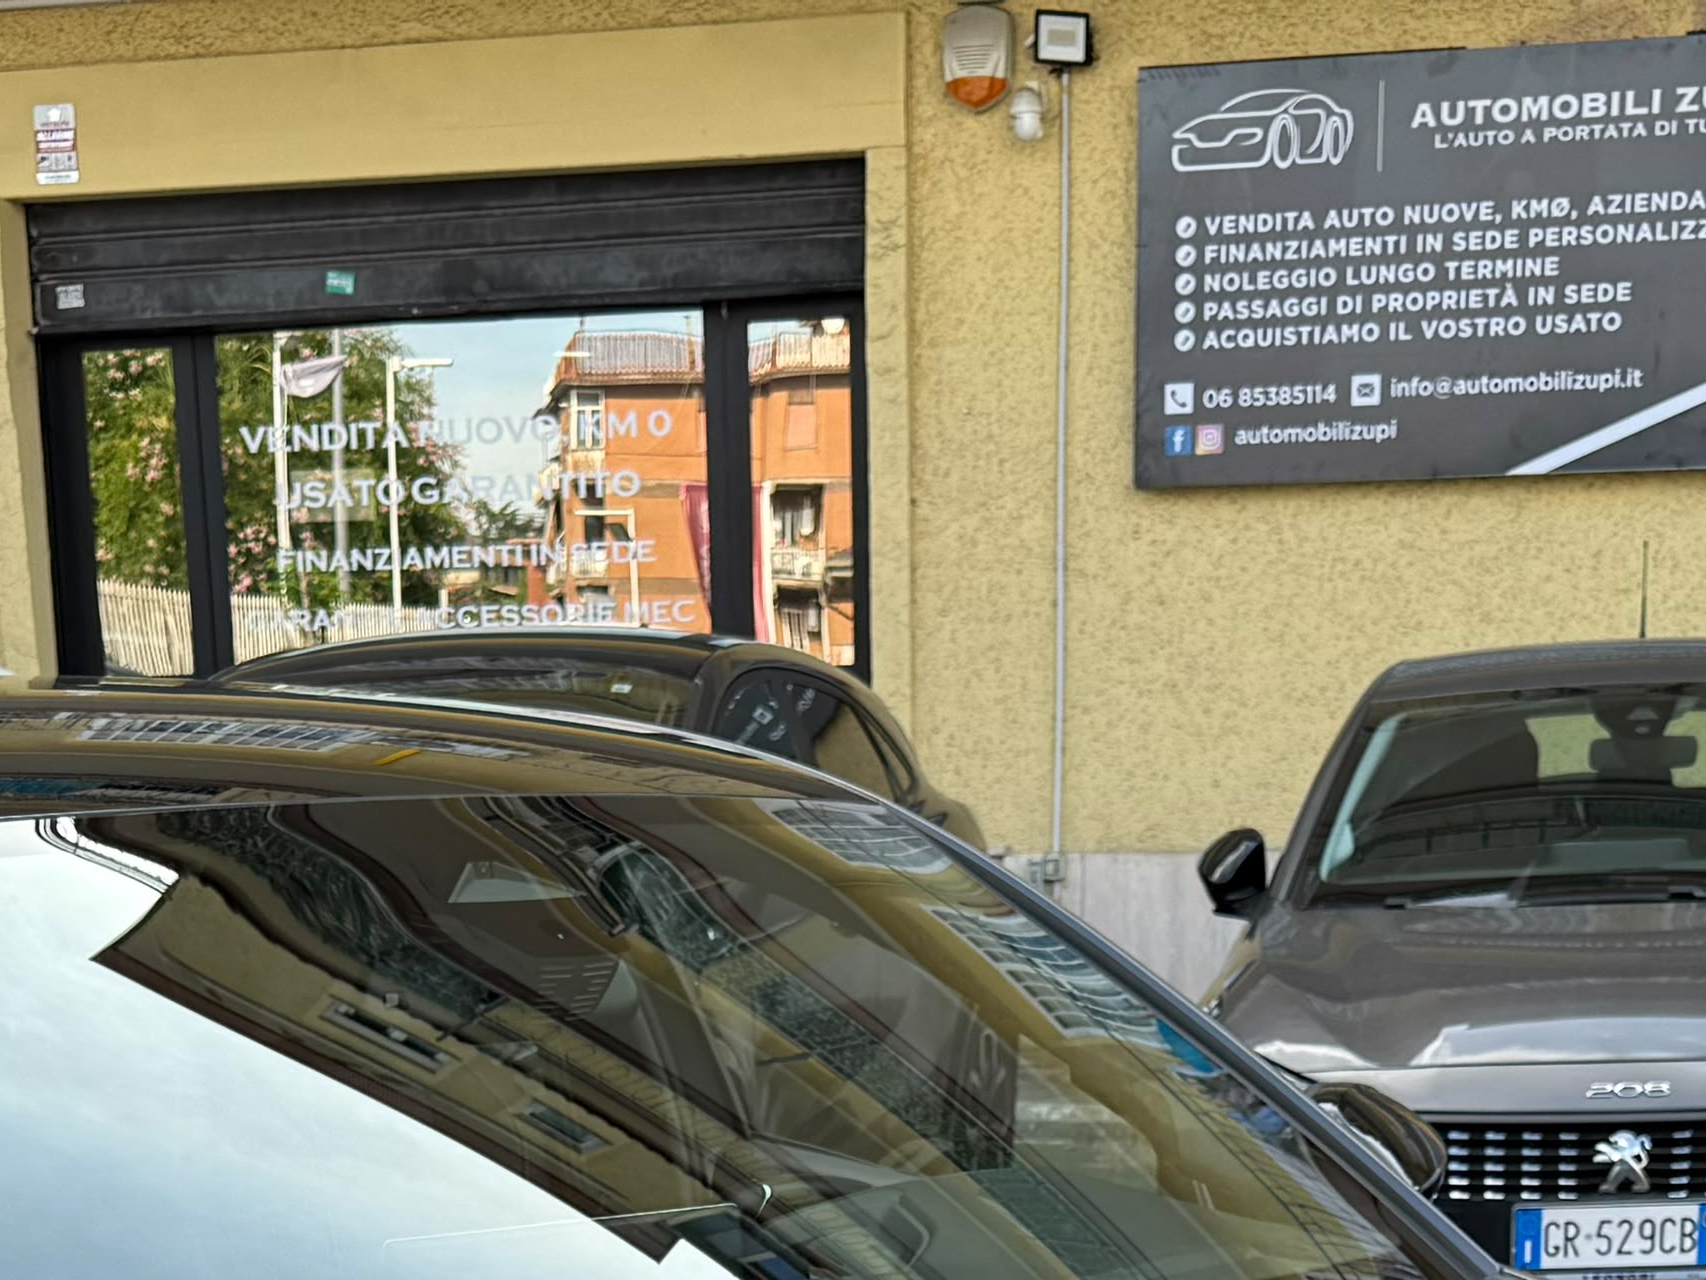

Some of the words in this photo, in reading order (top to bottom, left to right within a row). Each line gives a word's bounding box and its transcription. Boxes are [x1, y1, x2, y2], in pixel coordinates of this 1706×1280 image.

[1411, 89, 1661, 128] AUTOMOBILI
[1434, 129, 1515, 149] L'AUTO
[1521, 128, 1536, 144] A
[1543, 121, 1647, 142] PORTATA
[1654, 119, 1678, 137] DI
[1204, 211, 1315, 236] VENDITA
[1324, 206, 1394, 230] AUTO
[1404, 201, 1502, 226] NUOVE,
[1204, 235, 1407, 265] FINANZIAMENTI
[1417, 233, 1443, 253] IN
[1452, 229, 1520, 252] SEDE
[1204, 267, 1337, 293] NOLEGGIO
[1346, 263, 1435, 286] LUNGO
[1445, 257, 1560, 281] TERMINE
[1203, 297, 1327, 321] PASSAGGI
[1337, 295, 1362, 315] DI
[1372, 283, 1519, 313] PROPRIETÀ
[1528, 286, 1555, 307] IN
[1564, 282, 1633, 305] SEDE
[1202, 323, 1380, 350] ACQUISTIAMO
[1390, 321, 1412, 341] IL
[1421, 316, 1526, 340] VOSTRO
[1535, 311, 1622, 335] USATO
[1202, 388, 1233, 409] 06
[1237, 384, 1338, 408] 85385114
[1390, 368, 1644, 399] info@automobilizupi.it
[239, 420, 410, 454] VENDITA
[578, 411, 638, 440] KM
[1234, 419, 1398, 446] automobilizupi
[276, 479, 405, 510] USATO
[411, 470, 642, 505] GARANTITO
[276, 542, 528, 573] FINANZIAMENTI
[530, 542, 562, 567] IN
[570, 540, 657, 565] SEDE
[624, 599, 697, 625] MEC
[1586, 1080, 1671, 1099] 208
